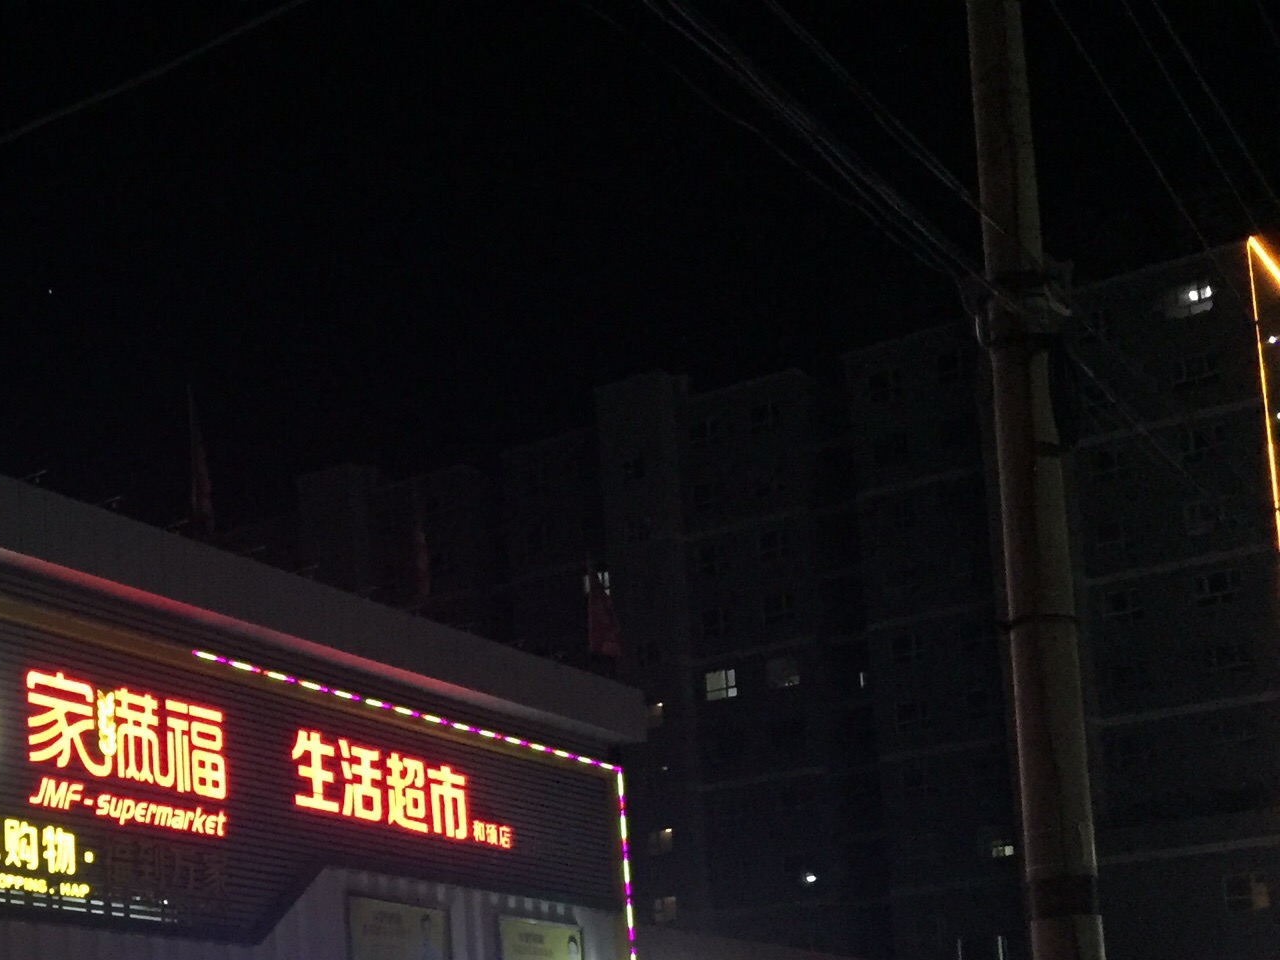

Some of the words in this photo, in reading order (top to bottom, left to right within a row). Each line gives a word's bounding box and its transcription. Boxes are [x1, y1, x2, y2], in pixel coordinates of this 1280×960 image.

[25, 669, 228, 801] 家满福
[291, 729, 469, 840] 生活超市
